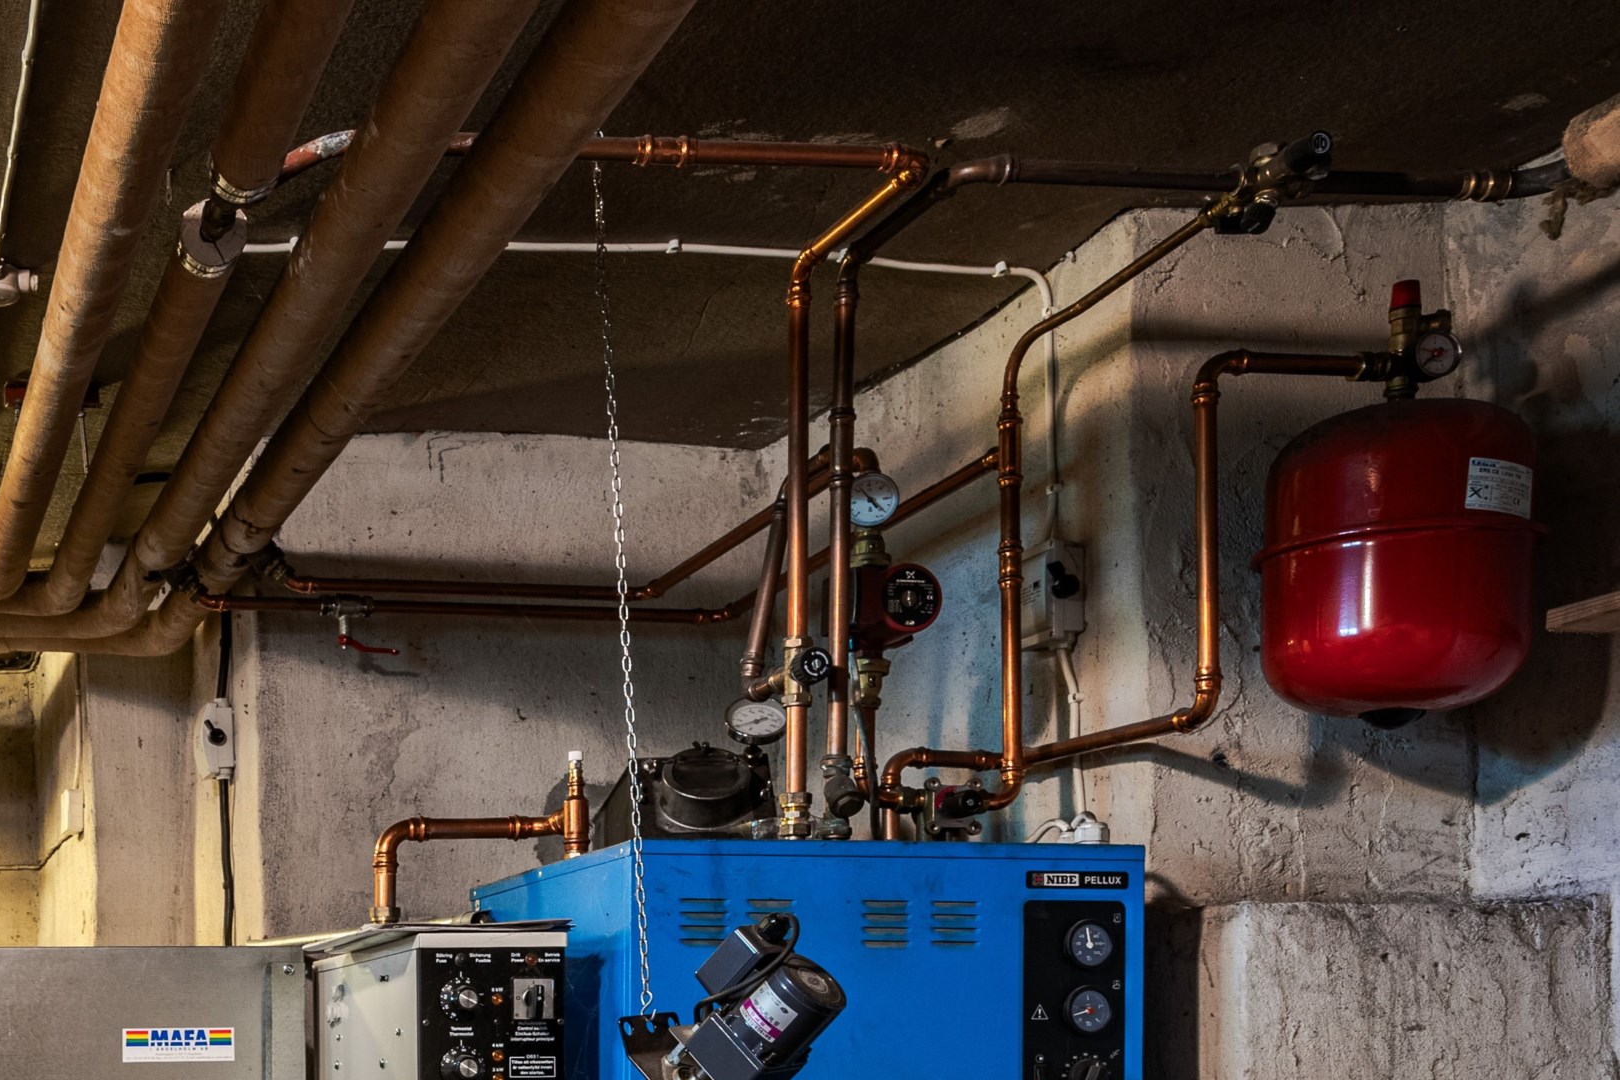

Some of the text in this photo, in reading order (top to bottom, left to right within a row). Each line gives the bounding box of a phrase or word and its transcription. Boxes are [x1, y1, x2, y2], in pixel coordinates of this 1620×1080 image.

[1046, 875, 1122, 885] NIBE PELLUX
[150, 1030, 208, 1046] MAFA
